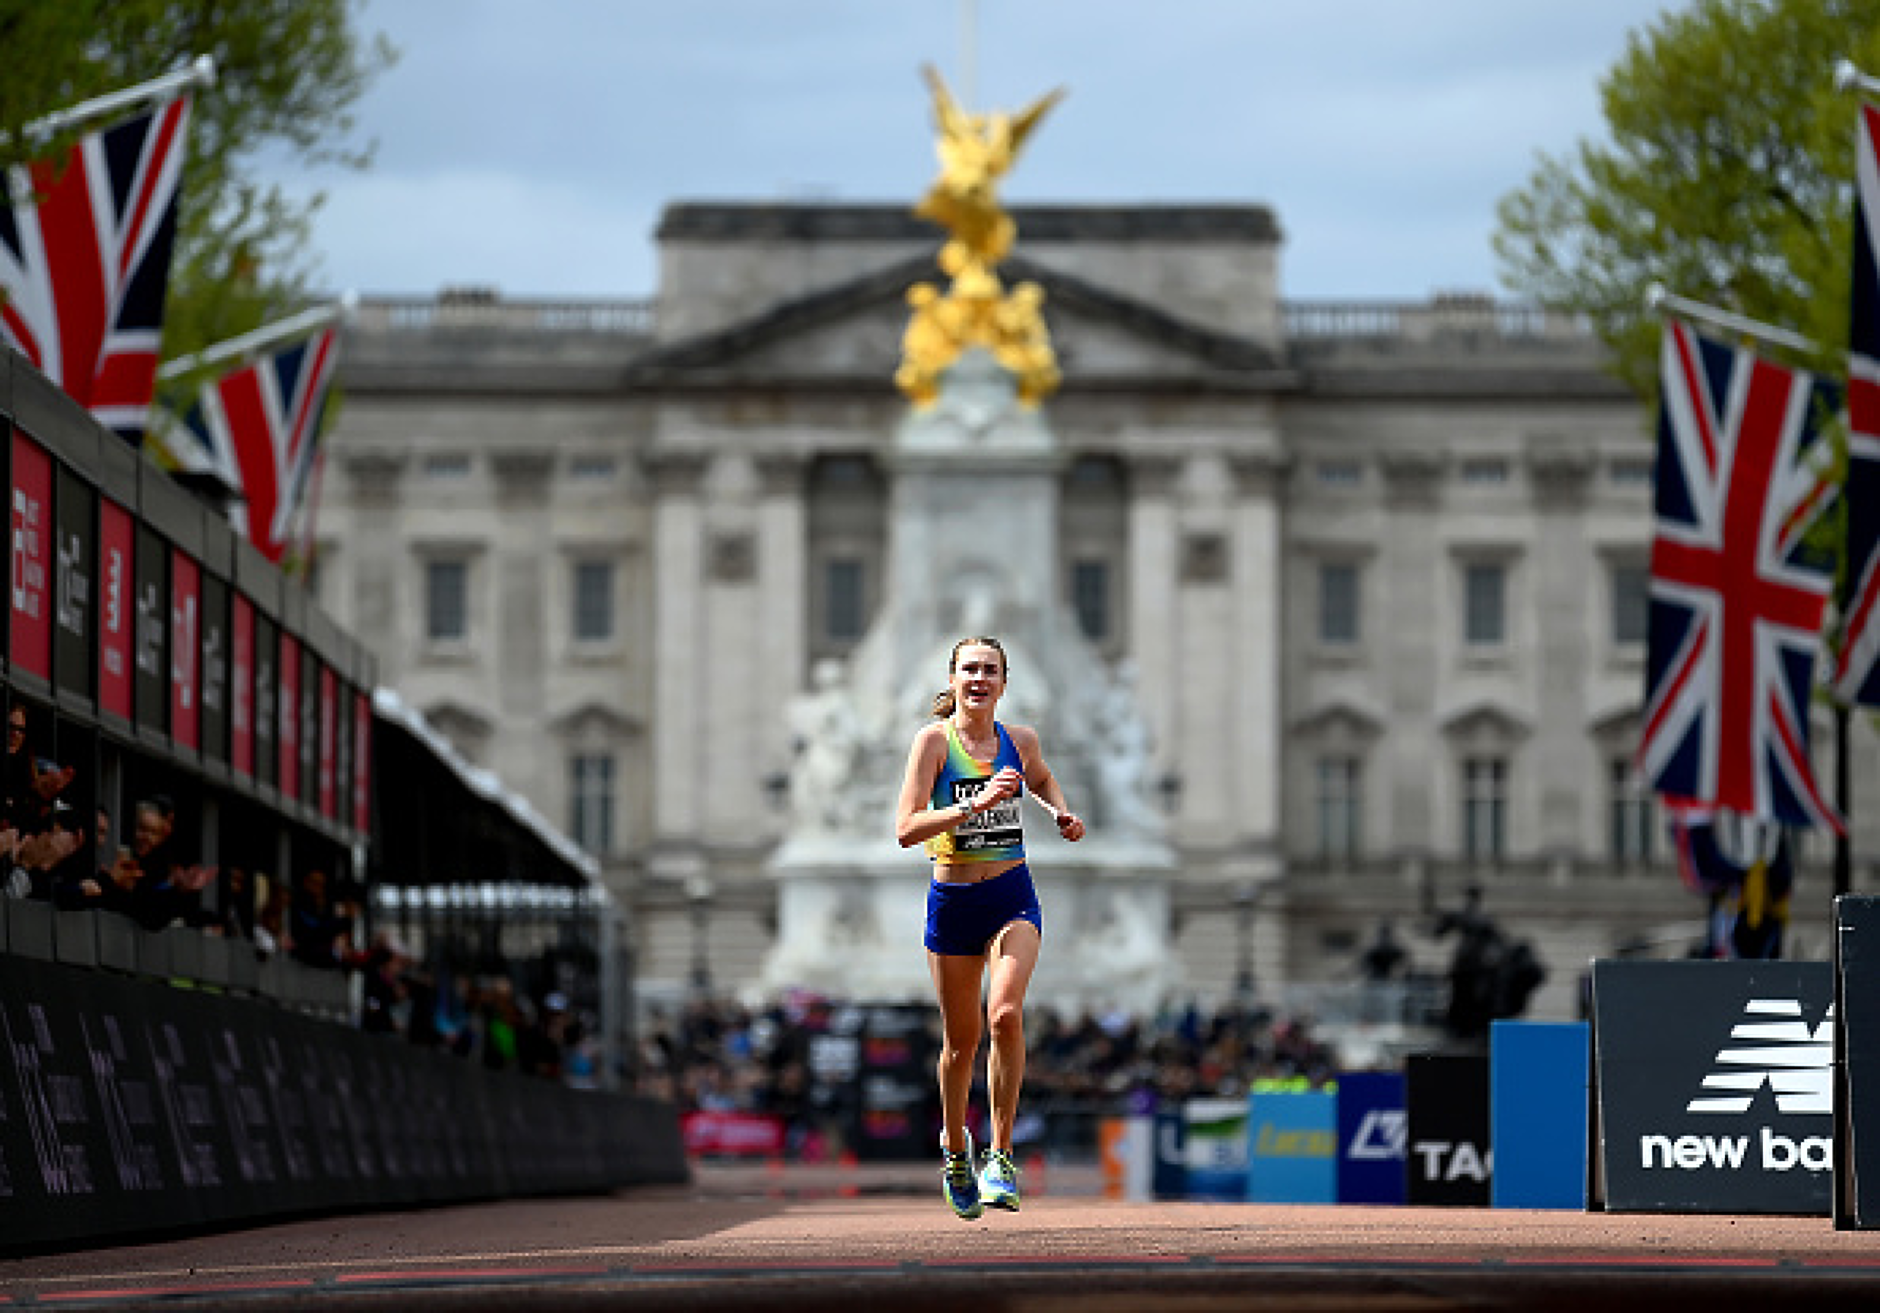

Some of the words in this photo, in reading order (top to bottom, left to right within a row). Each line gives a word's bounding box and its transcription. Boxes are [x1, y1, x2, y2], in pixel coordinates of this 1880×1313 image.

[1413, 1140, 1494, 1182] TA
[1641, 1135, 1749, 1169] new
[1760, 1126, 1833, 1171] ba
